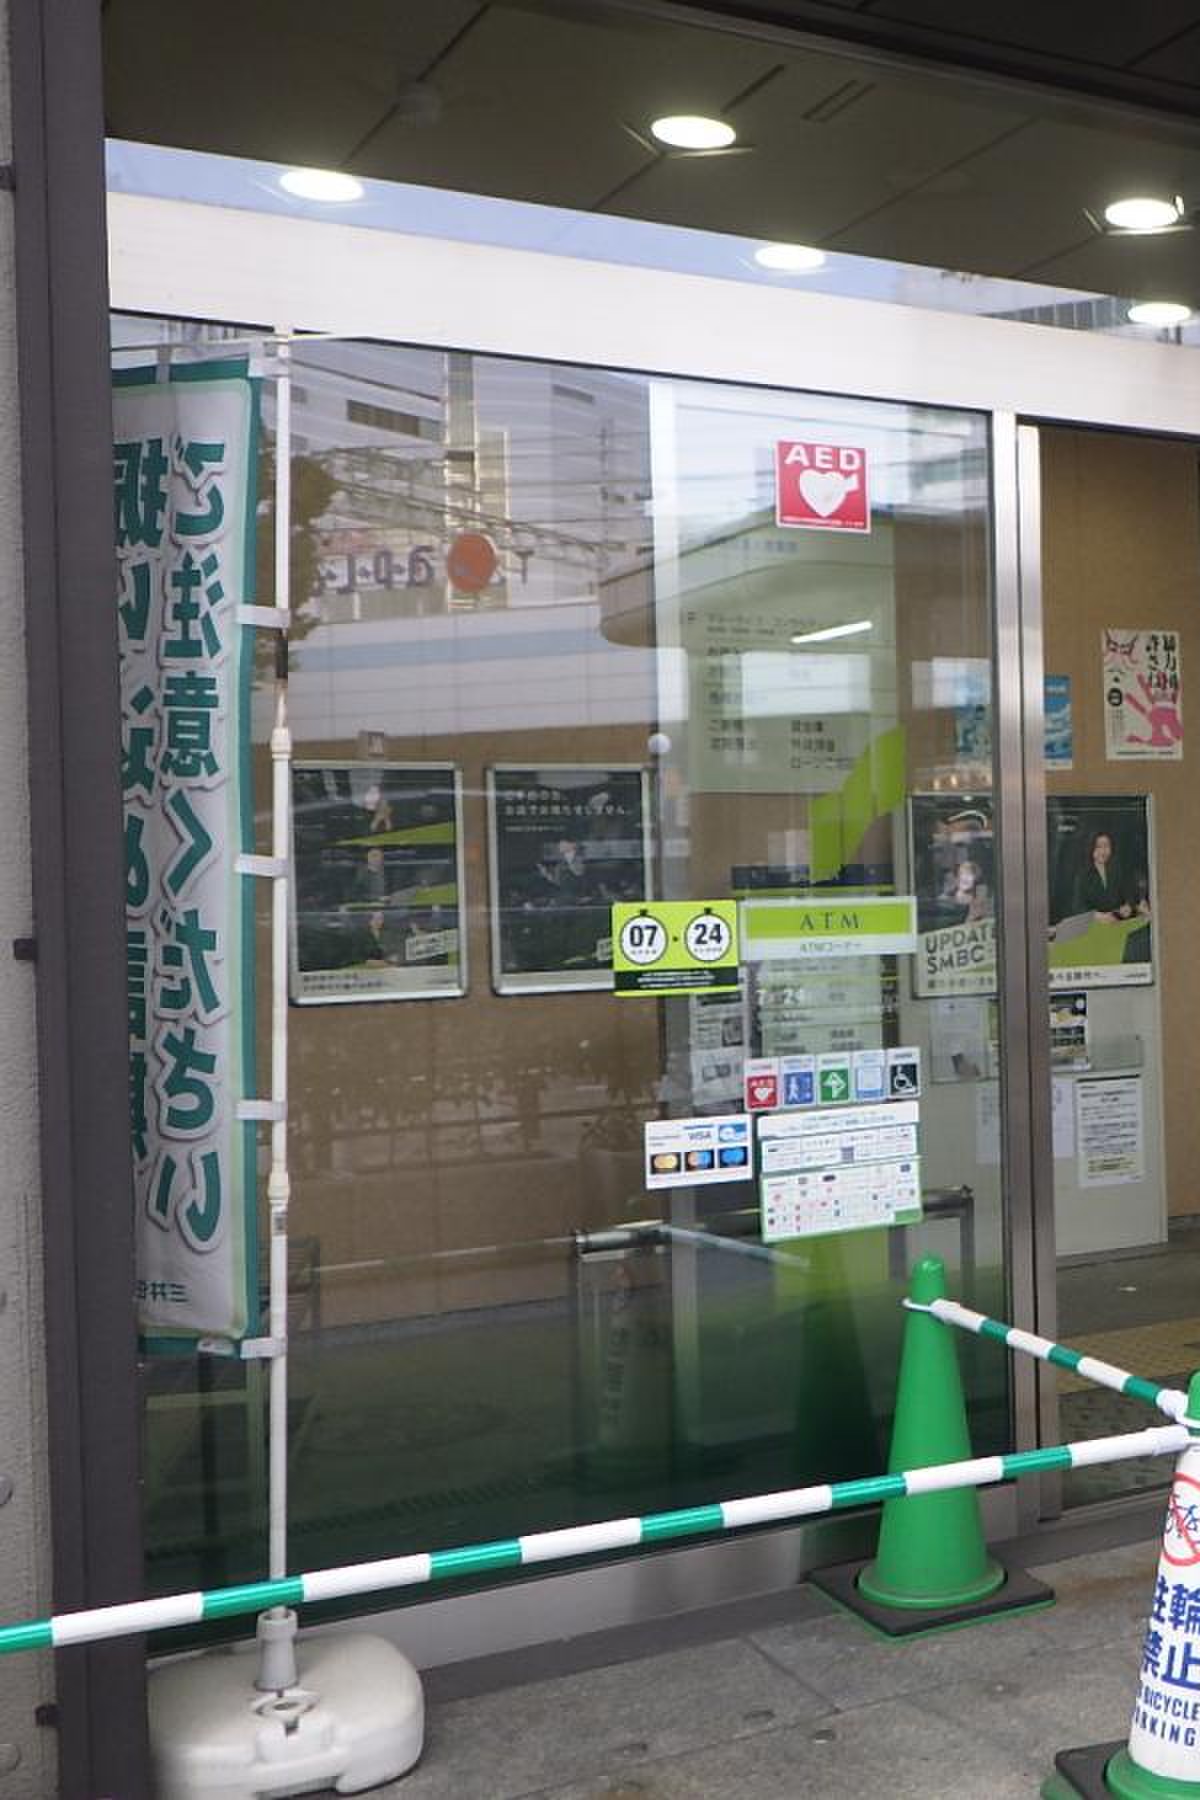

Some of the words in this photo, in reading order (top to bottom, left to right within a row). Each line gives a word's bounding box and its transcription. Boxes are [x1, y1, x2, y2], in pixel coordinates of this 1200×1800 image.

[784, 445, 861, 471] AED
[800, 911, 859, 931] ATM
[630, 925, 658, 947] 07
[694, 924, 722, 945] 24
[927, 944, 985, 975] SMBC
[1144, 1685, 1200, 1721] BICYCLE
